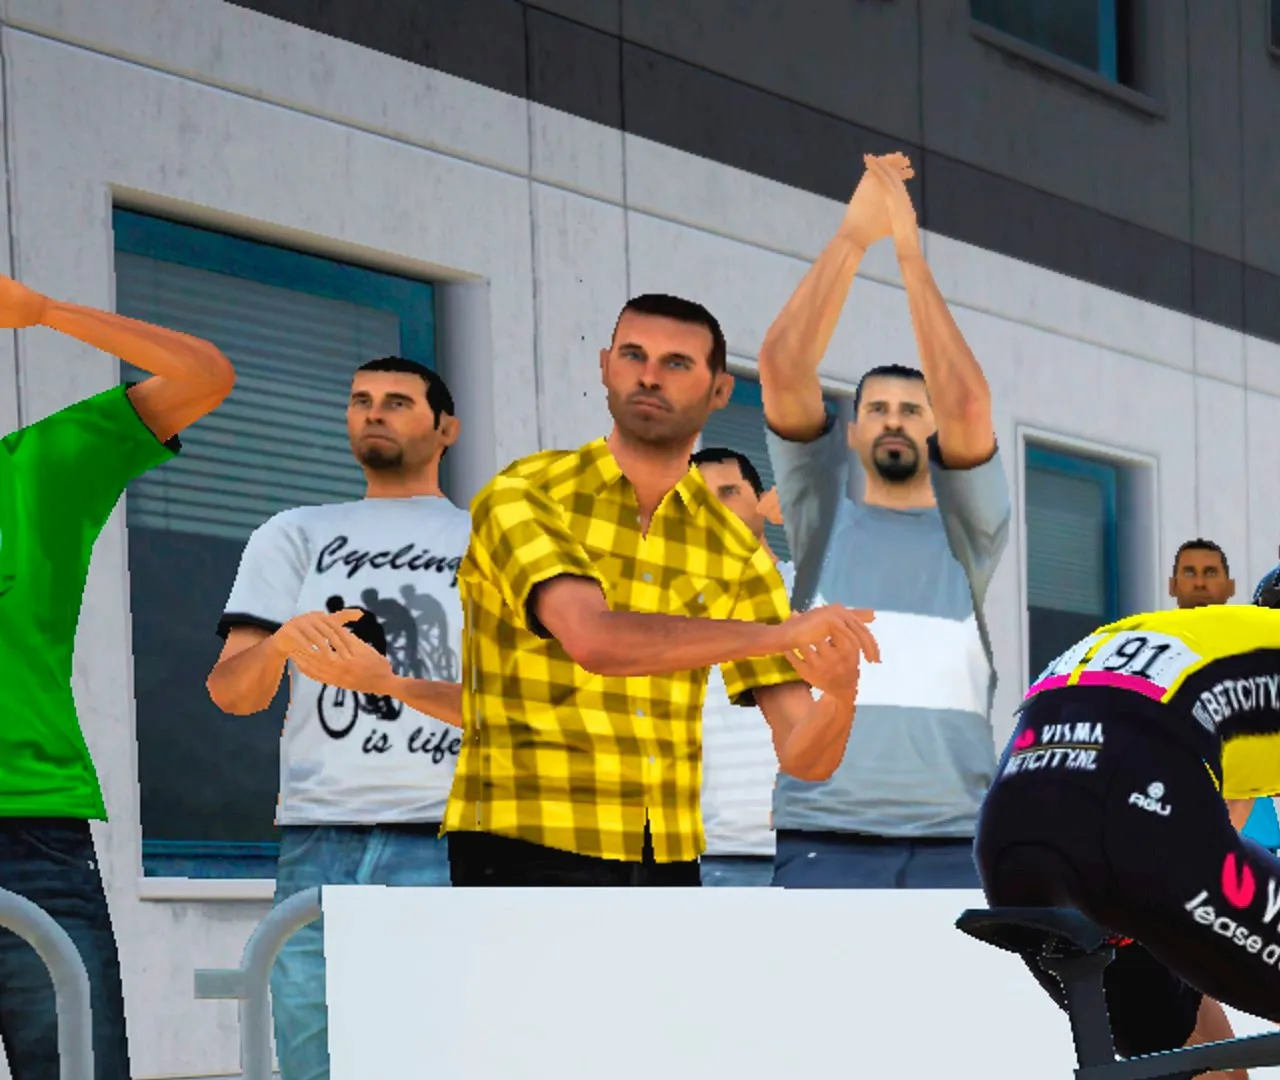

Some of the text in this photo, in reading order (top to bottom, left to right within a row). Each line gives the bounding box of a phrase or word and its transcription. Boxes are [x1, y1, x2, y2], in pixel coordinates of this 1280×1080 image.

[316, 535, 462, 587] Cycling
[1104, 637, 1171, 679] 91
[362, 726, 461, 764] is life
[1042, 722, 1104, 744] VISMA
[1184, 889, 1262, 953] lease
